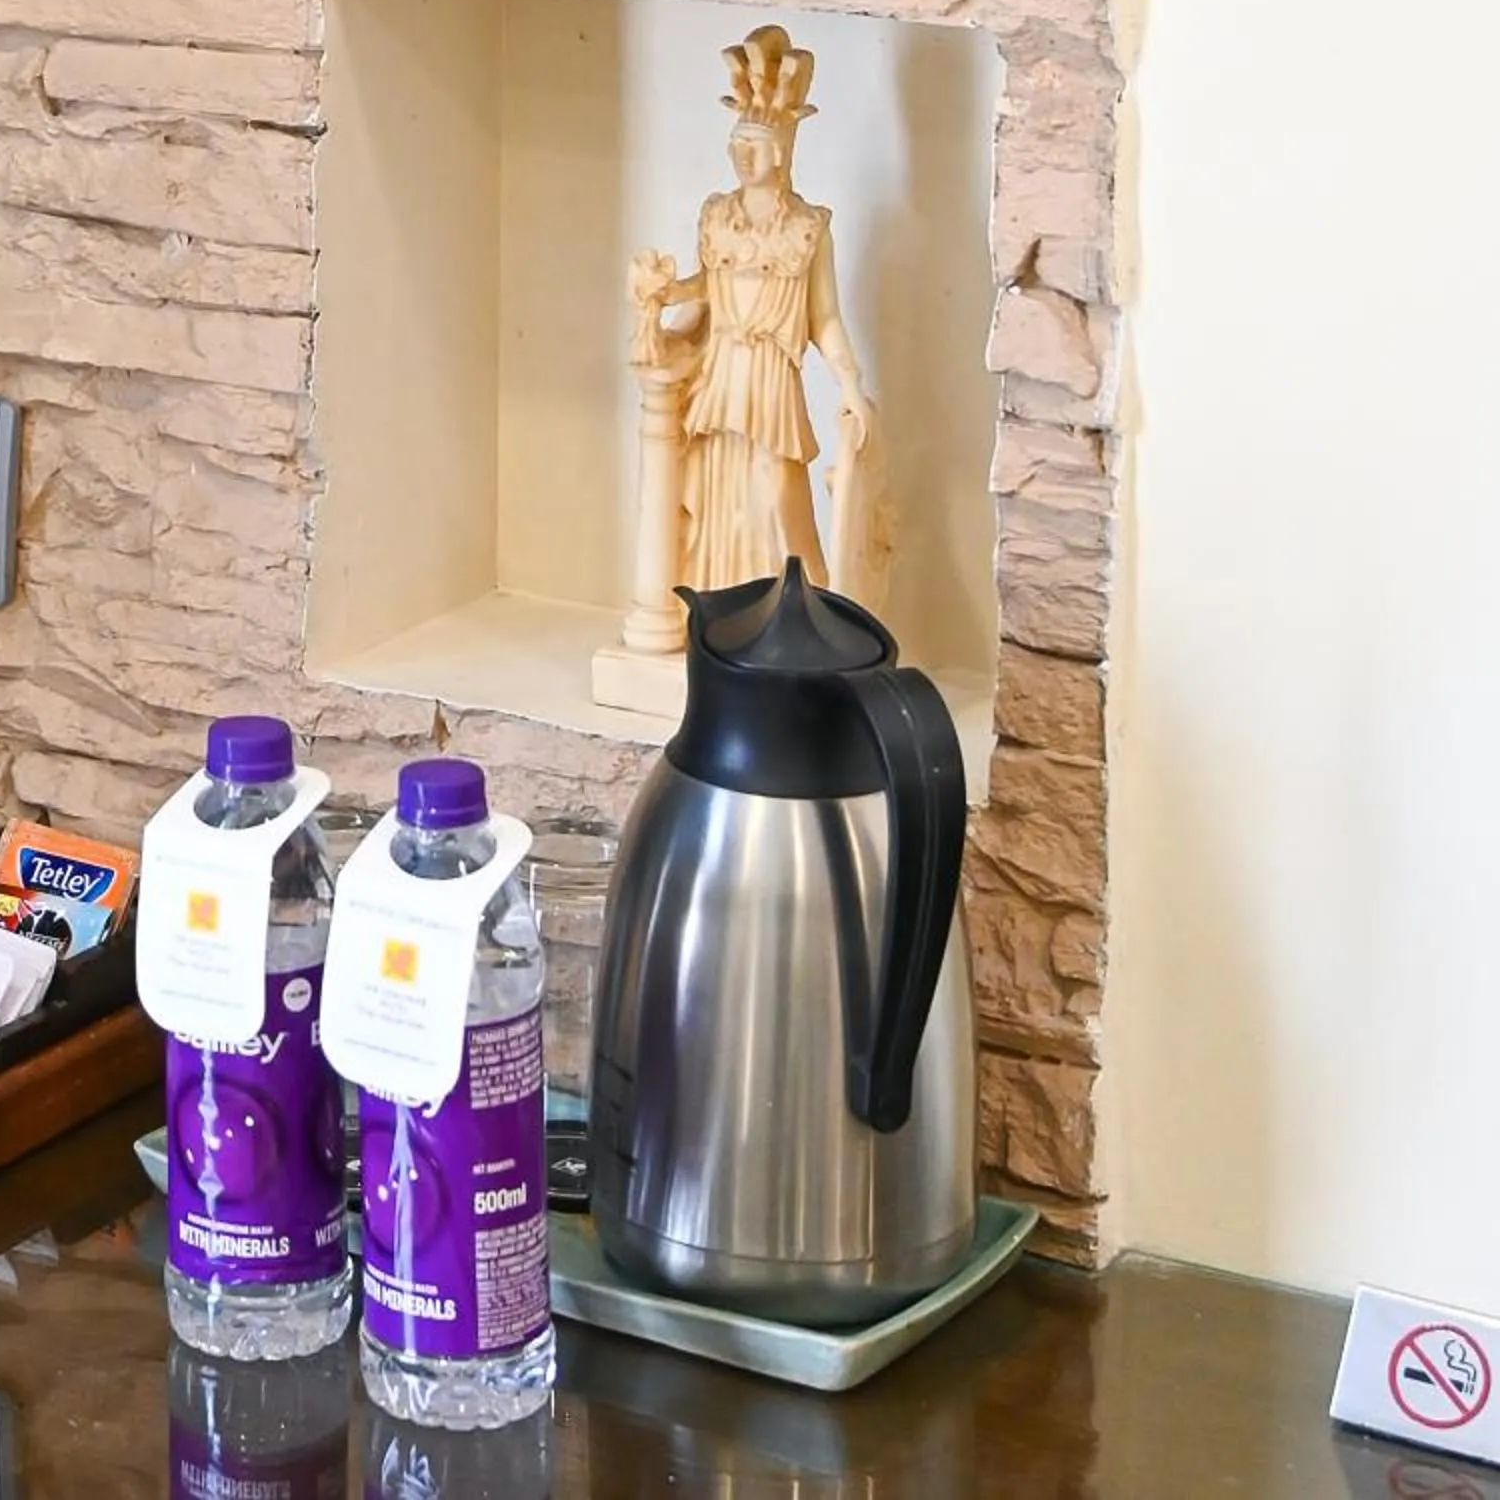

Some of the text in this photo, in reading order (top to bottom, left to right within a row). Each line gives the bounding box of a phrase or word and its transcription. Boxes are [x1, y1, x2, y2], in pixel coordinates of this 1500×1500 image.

[29, 856, 105, 900] Tetley
[474, 1181, 527, 1215] 500ml
[212, 1233, 291, 1259] MINERALS
[381, 1285, 457, 1321] MINERALS
